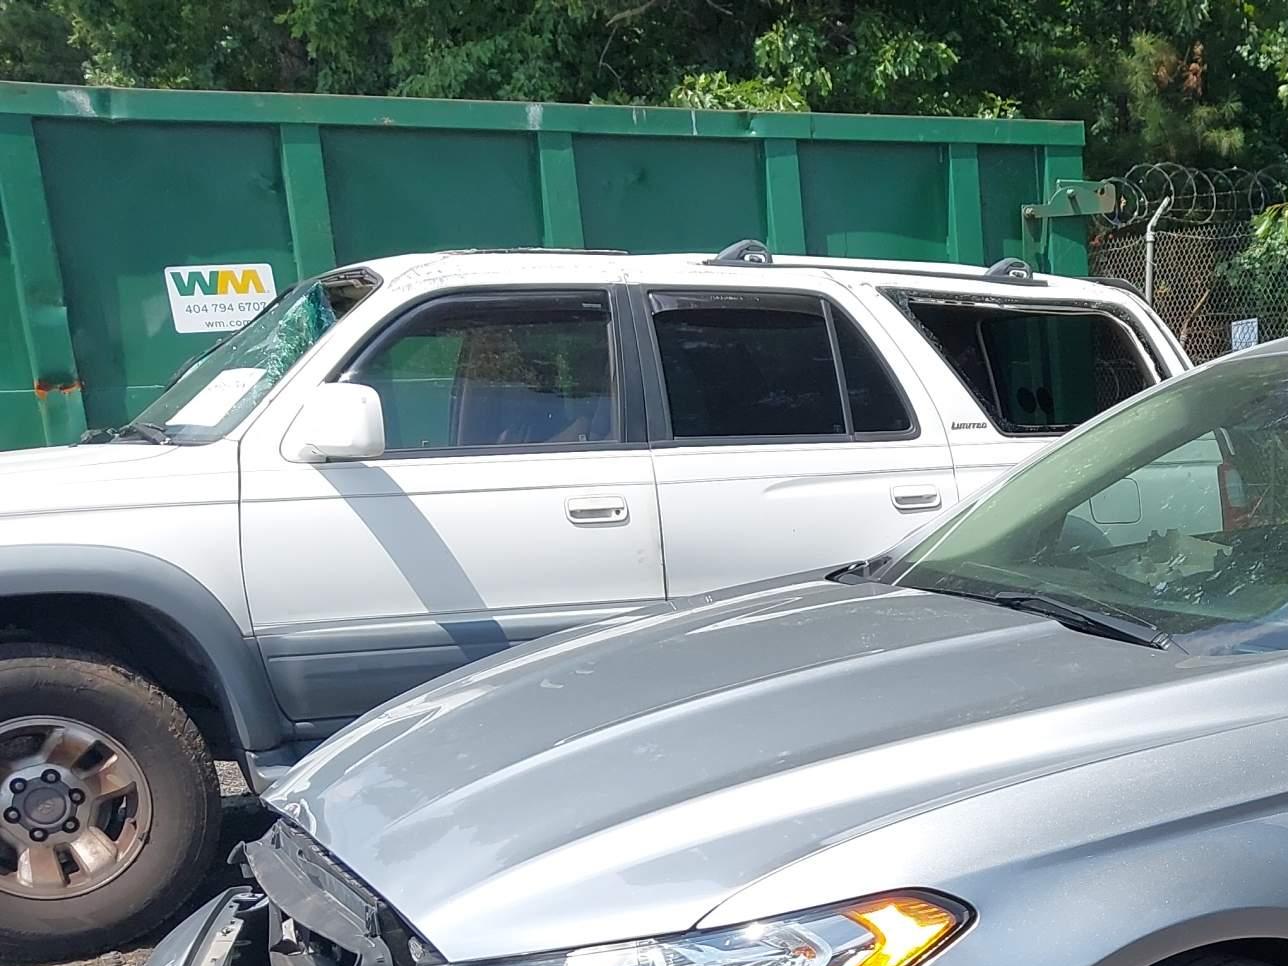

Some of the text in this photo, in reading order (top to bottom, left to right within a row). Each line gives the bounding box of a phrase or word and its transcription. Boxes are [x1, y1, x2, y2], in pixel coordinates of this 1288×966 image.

[169, 270, 266, 296] WM
[185, 304, 208, 314] 404
[211, 303, 234, 313] 794
